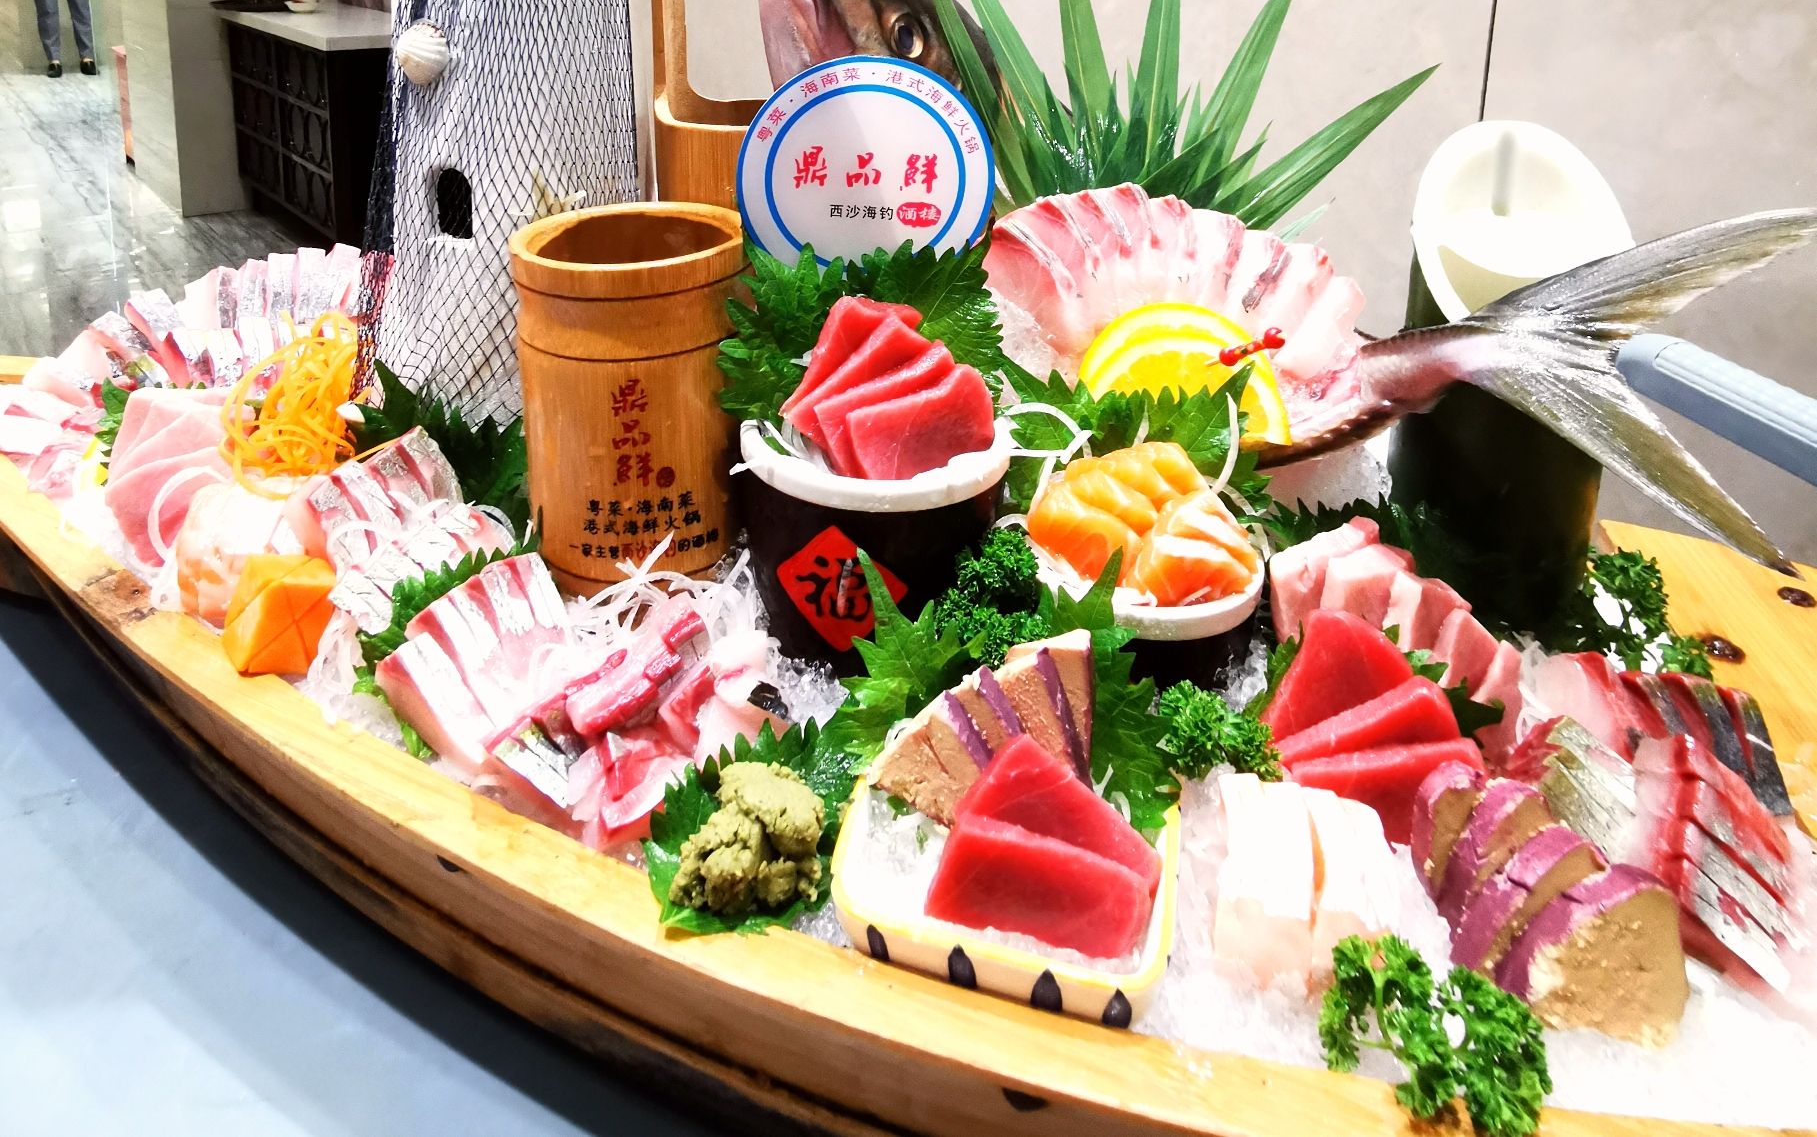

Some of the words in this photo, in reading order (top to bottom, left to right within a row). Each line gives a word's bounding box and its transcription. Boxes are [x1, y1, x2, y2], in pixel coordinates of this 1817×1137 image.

[583, 510, 701, 536] 港式海鲜火锅
[796, 555, 871, 622] 福
